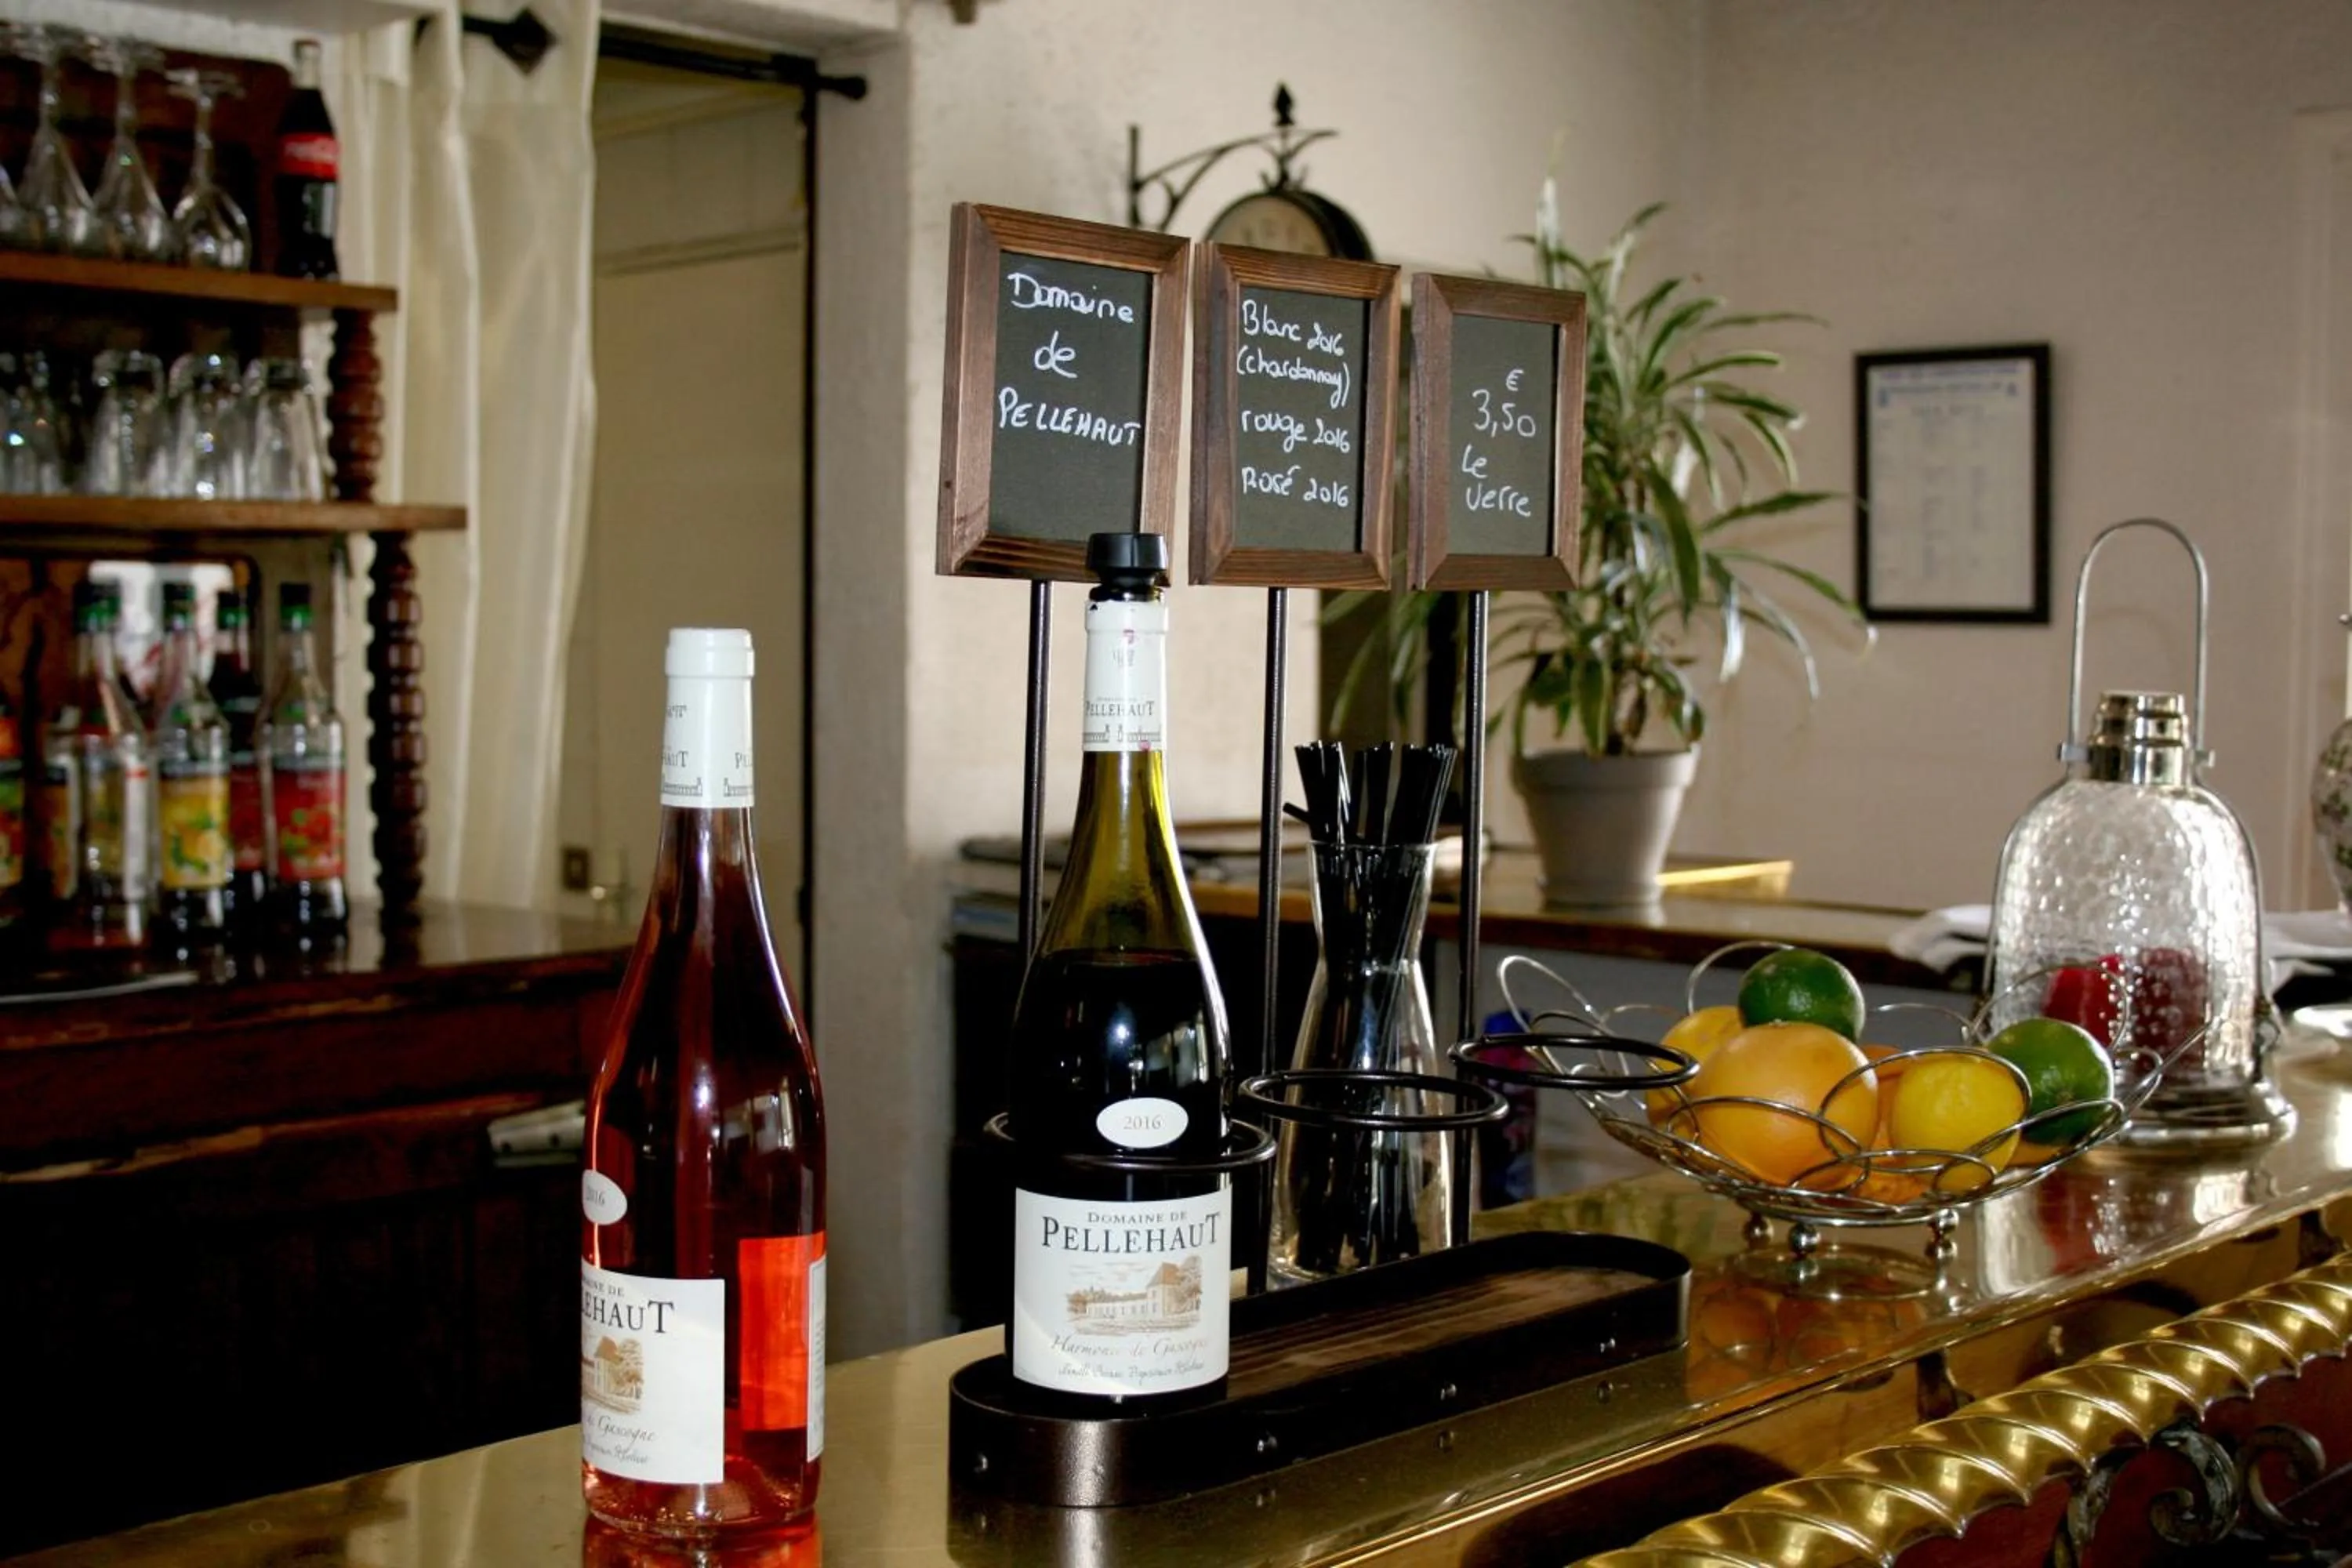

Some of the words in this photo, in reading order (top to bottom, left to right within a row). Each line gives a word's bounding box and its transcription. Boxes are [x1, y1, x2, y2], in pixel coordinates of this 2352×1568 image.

[1007, 271, 1134, 323] Domaine
[1241, 299, 1302, 342] Blanc
[1306, 321, 1345, 357] 2016
[1033, 329, 1078, 379] de
[1505, 368, 1524, 392] €
[998, 386, 1142, 446] PELLEHAUT
[1241, 410, 1308, 453] rouge
[1312, 417, 1351, 454] 2016
[1472, 388, 1536, 437] 3,50
[1241, 464, 1301, 496] Rosé
[1302, 477, 1349, 508] 2016
[1123, 1115, 1162, 1131] 2016
[1042, 1210, 1221, 1254] PELLEHAUT
[1087, 1210, 1163, 1224] DOMAINE
[1171, 1210, 1189, 1221] DE
[608, 1284, 625, 1298] DE
